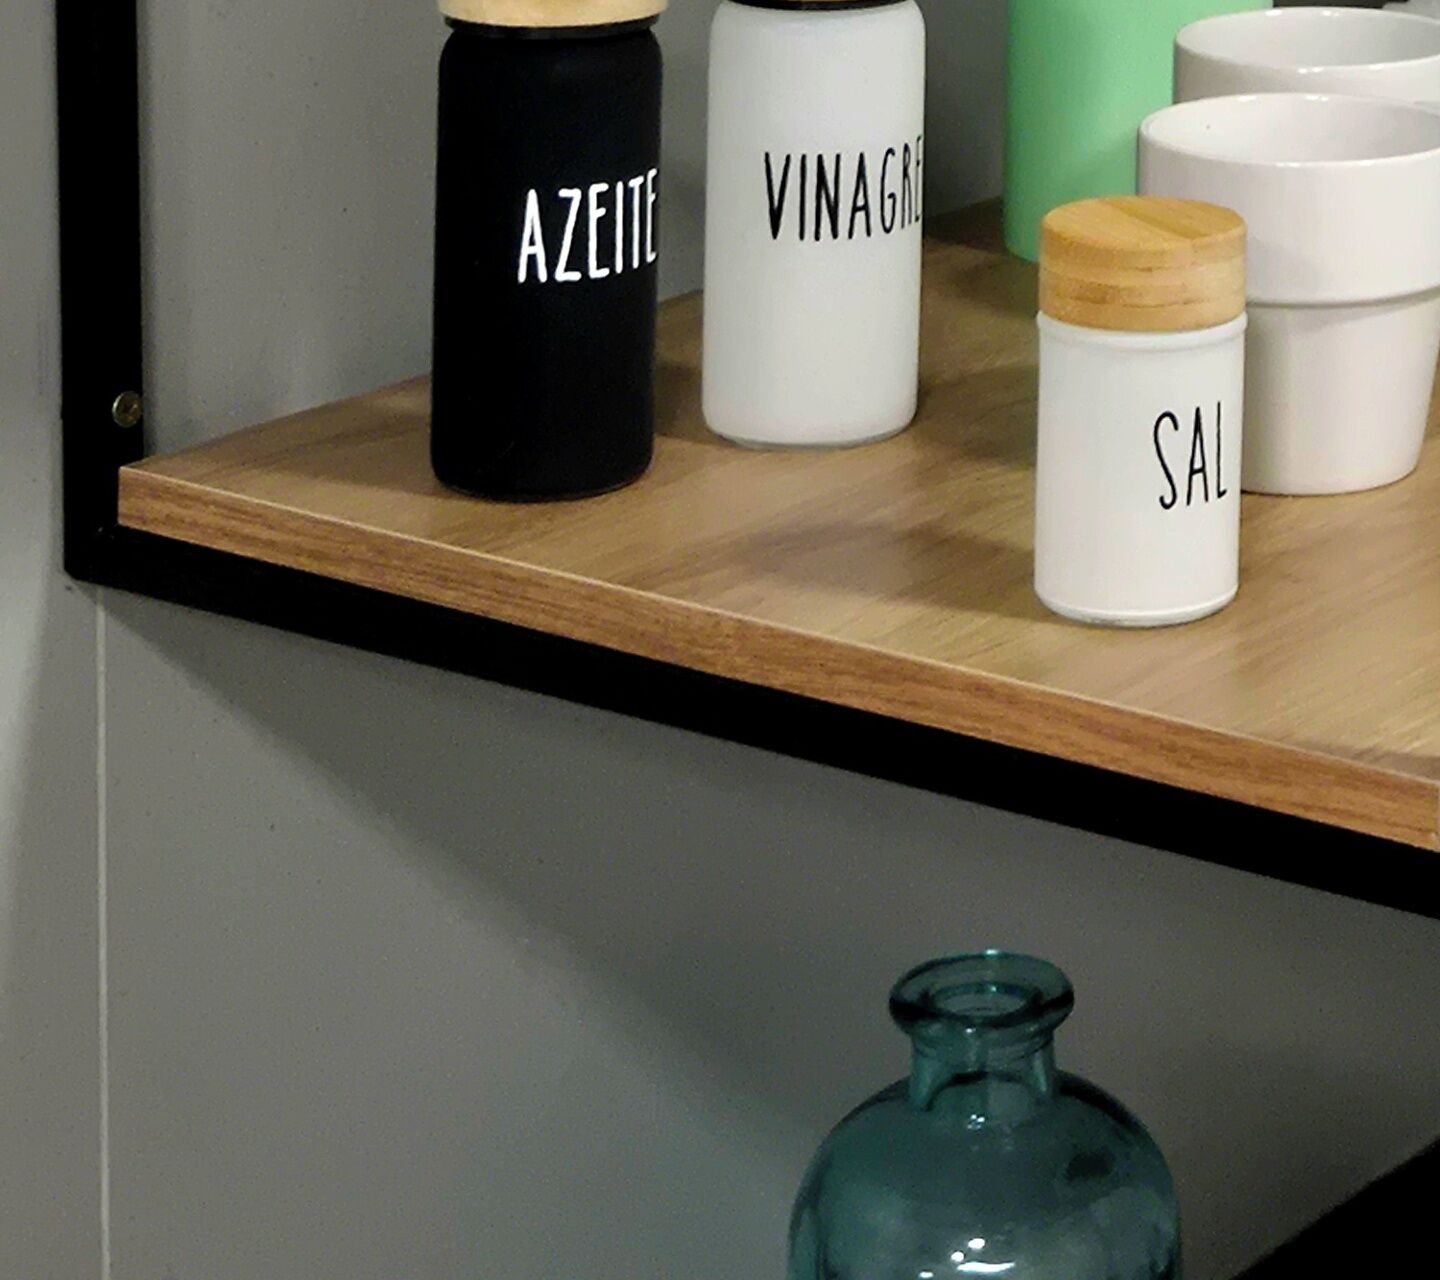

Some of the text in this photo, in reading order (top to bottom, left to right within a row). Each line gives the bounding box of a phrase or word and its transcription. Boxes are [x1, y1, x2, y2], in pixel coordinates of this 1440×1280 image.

[518, 168, 657, 283] AZEITE
[764, 135, 922, 241] VINAGRE
[1153, 401, 1227, 510] SAL
